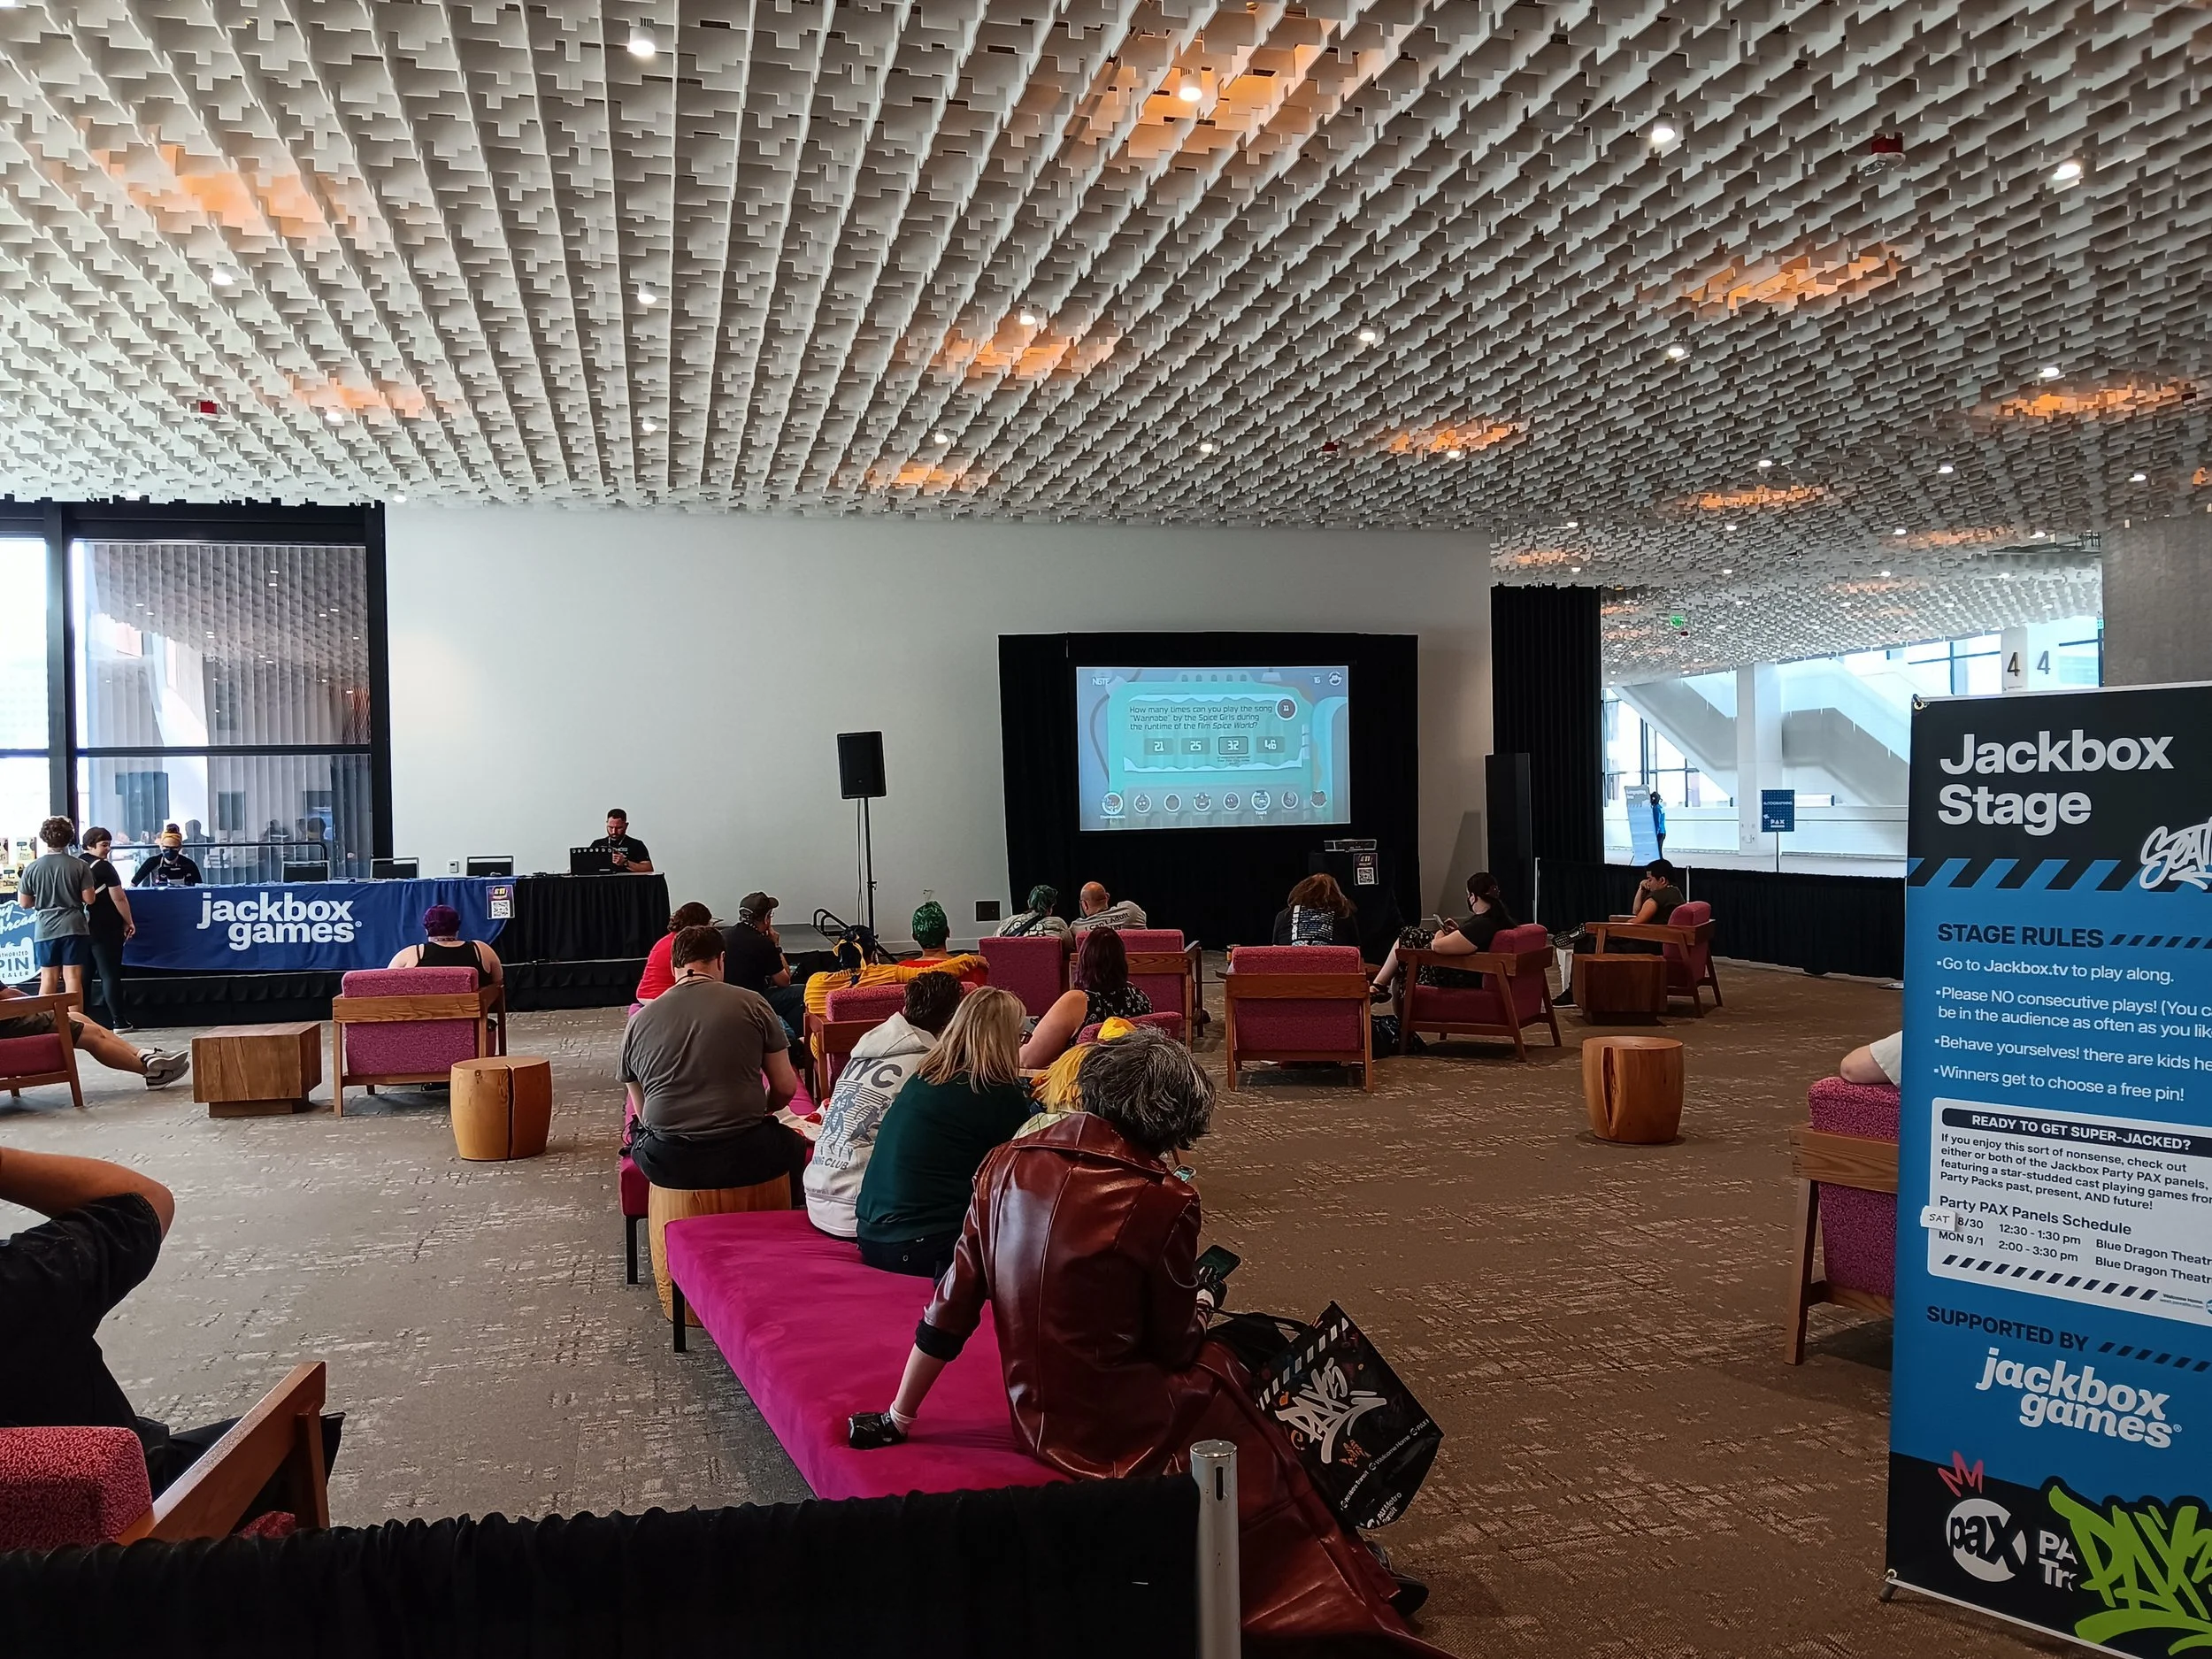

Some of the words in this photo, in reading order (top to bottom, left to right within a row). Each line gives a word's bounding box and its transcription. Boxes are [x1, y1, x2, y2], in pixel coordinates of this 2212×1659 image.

[2007, 651, 2021, 676] 4
[2037, 650, 2051, 674] 4
[1198, 713, 1217, 722] Spice
[1154, 741, 1164, 752] 21
[1190, 741, 1202, 751] 25
[1228, 740, 1239, 750] 32
[1264, 740, 1277, 750] 46
[1939, 729, 2175, 775] Jackbox
[1938, 783, 2092, 836] Stage
[196, 892, 354, 929] jackbox
[1110, 912, 1129, 924] Adult
[228, 922, 355, 951] games
[1938, 923, 2016, 945] STAGE
[2022, 926, 2105, 949] RULES
[1943, 957, 1962, 971] Go
[1965, 959, 1980, 972] to
[1984, 959, 2069, 976] Jackbox.tv
[2071, 964, 2088, 977] to
[2091, 964, 2124, 982] play
[2126, 966, 2175, 986] along.
[1941, 986, 1988, 1002] Please
[1991, 989, 2015, 1003] NO
[2017, 995, 2109, 1010] consecutive
[2113, 998, 2157, 1016] plays!
[2161, 1000, 2198, 1017] (You
[1938, 1005, 1956, 1019] be
[1959, 1007, 1971, 1020] in
[1975, 1008, 1998, 1023] the
[2001, 1012, 2070, 1027] audience
[2072, 1018, 2091, 1030] as
[2093, 1017, 2134, 1033] often
[2138, 1023, 2157, 1034] as
[2161, 1024, 2191, 1039] you
[2194, 1024, 2212, 1039] lik
[1940, 1035, 1993, 1052] Behave
[1996, 1042, 2079, 1060] yourselves!
[2083, 1048, 2124, 1064] there
[2127, 1053, 2154, 1066] are
[2157, 1053, 2191, 1070] kids
[839, 1058, 902, 1089] NYC
[1939, 1064, 2000, 1083] Winners
[2001, 1073, 2027, 1088] get
[2030, 1074, 2046, 1087] to
[2047, 1076, 2104, 1094] choose
[2107, 1083, 2117, 1095] a
[2120, 1082, 2152, 1098] free
[2155, 1086, 2185, 1102] pin!
[1972, 1115, 2017, 1131] READY
[2019, 1119, 2039, 1134] TO
[2041, 1122, 2069, 1137] GET
[2070, 1125, 2191, 1150] SUPER-JACKED?
[825, 1157, 849, 1170] CLUB
[1941, 1133, 1948, 1142] If
[1951, 1135, 1970, 1145] you
[1972, 1138, 2001, 1150] enjoy
[2004, 1141, 2025, 1152] this
[2027, 1145, 2049, 1156] sort
[2052, 1148, 2064, 1157] of
[2067, 1150, 2124, 1166] nonsense,
[2127, 1157, 2163, 1170] check
[2166, 1163, 2187, 1173] out
[1941, 1147, 1972, 1158] either
[1975, 1152, 1986, 1161] or
[1988, 1152, 2014, 1164] both
[2016, 1156, 2027, 1165] of
[2030, 1157, 2047, 1168] the
[2051, 1161, 2100, 1175] Jackbox
[2102, 1166, 2134, 1182] Party
[2136, 1171, 2162, 1184] PAX
[2164, 1177, 2208, 1191] panels,
[1940, 1171, 1970, 1186] Party
[1971, 1175, 2003, 1189] Packs
[2006, 1182, 2033, 1194] past,
[2035, 1186, 2082, 1202] present,
[2085, 1192, 2110, 1203] AND
[2113, 1196, 2154, 1210] future!
[1941, 1159, 1989, 1176] featuring
[2001, 1168, 2072, 1185] star-studded
[2076, 1179, 2101, 1189] cast
[2102, 1182, 2145, 1197] playing
[2147, 1189, 2189, 1202] games
[1929, 1213, 1950, 1224] SAT
[1939, 1195, 1977, 1214] Party
[1980, 1202, 2008, 1217] PAX
[2012, 1207, 2059, 1224] Panels
[2062, 1214, 2132, 1235] Schedule
[1939, 1230, 1964, 1243] MON
[1966, 1235, 1984, 1246] 9/1
[1998, 1240, 2023, 1253] 2:00
[2032, 1246, 2058, 1258] 3:30
[2060, 1252, 2079, 1262] pm
[2095, 1256, 2122, 1269] Blue
[2124, 1261, 2168, 1277] Dragon
[1957, 1217, 1984, 1229] 8/30
[1999, 1223, 2028, 1237] 12:30
[2038, 1230, 2060, 1241] 1:30
[2063, 1235, 2081, 1245] pm
[2095, 1239, 2122, 1251] Blue
[2124, 1243, 2168, 1259] Dragon
[1927, 1305, 2055, 1346] SUPPORTED
[2059, 1333, 2090, 1352] BY
[1975, 1347, 2171, 1421] jackbox
[2019, 1393, 2173, 1449] games
